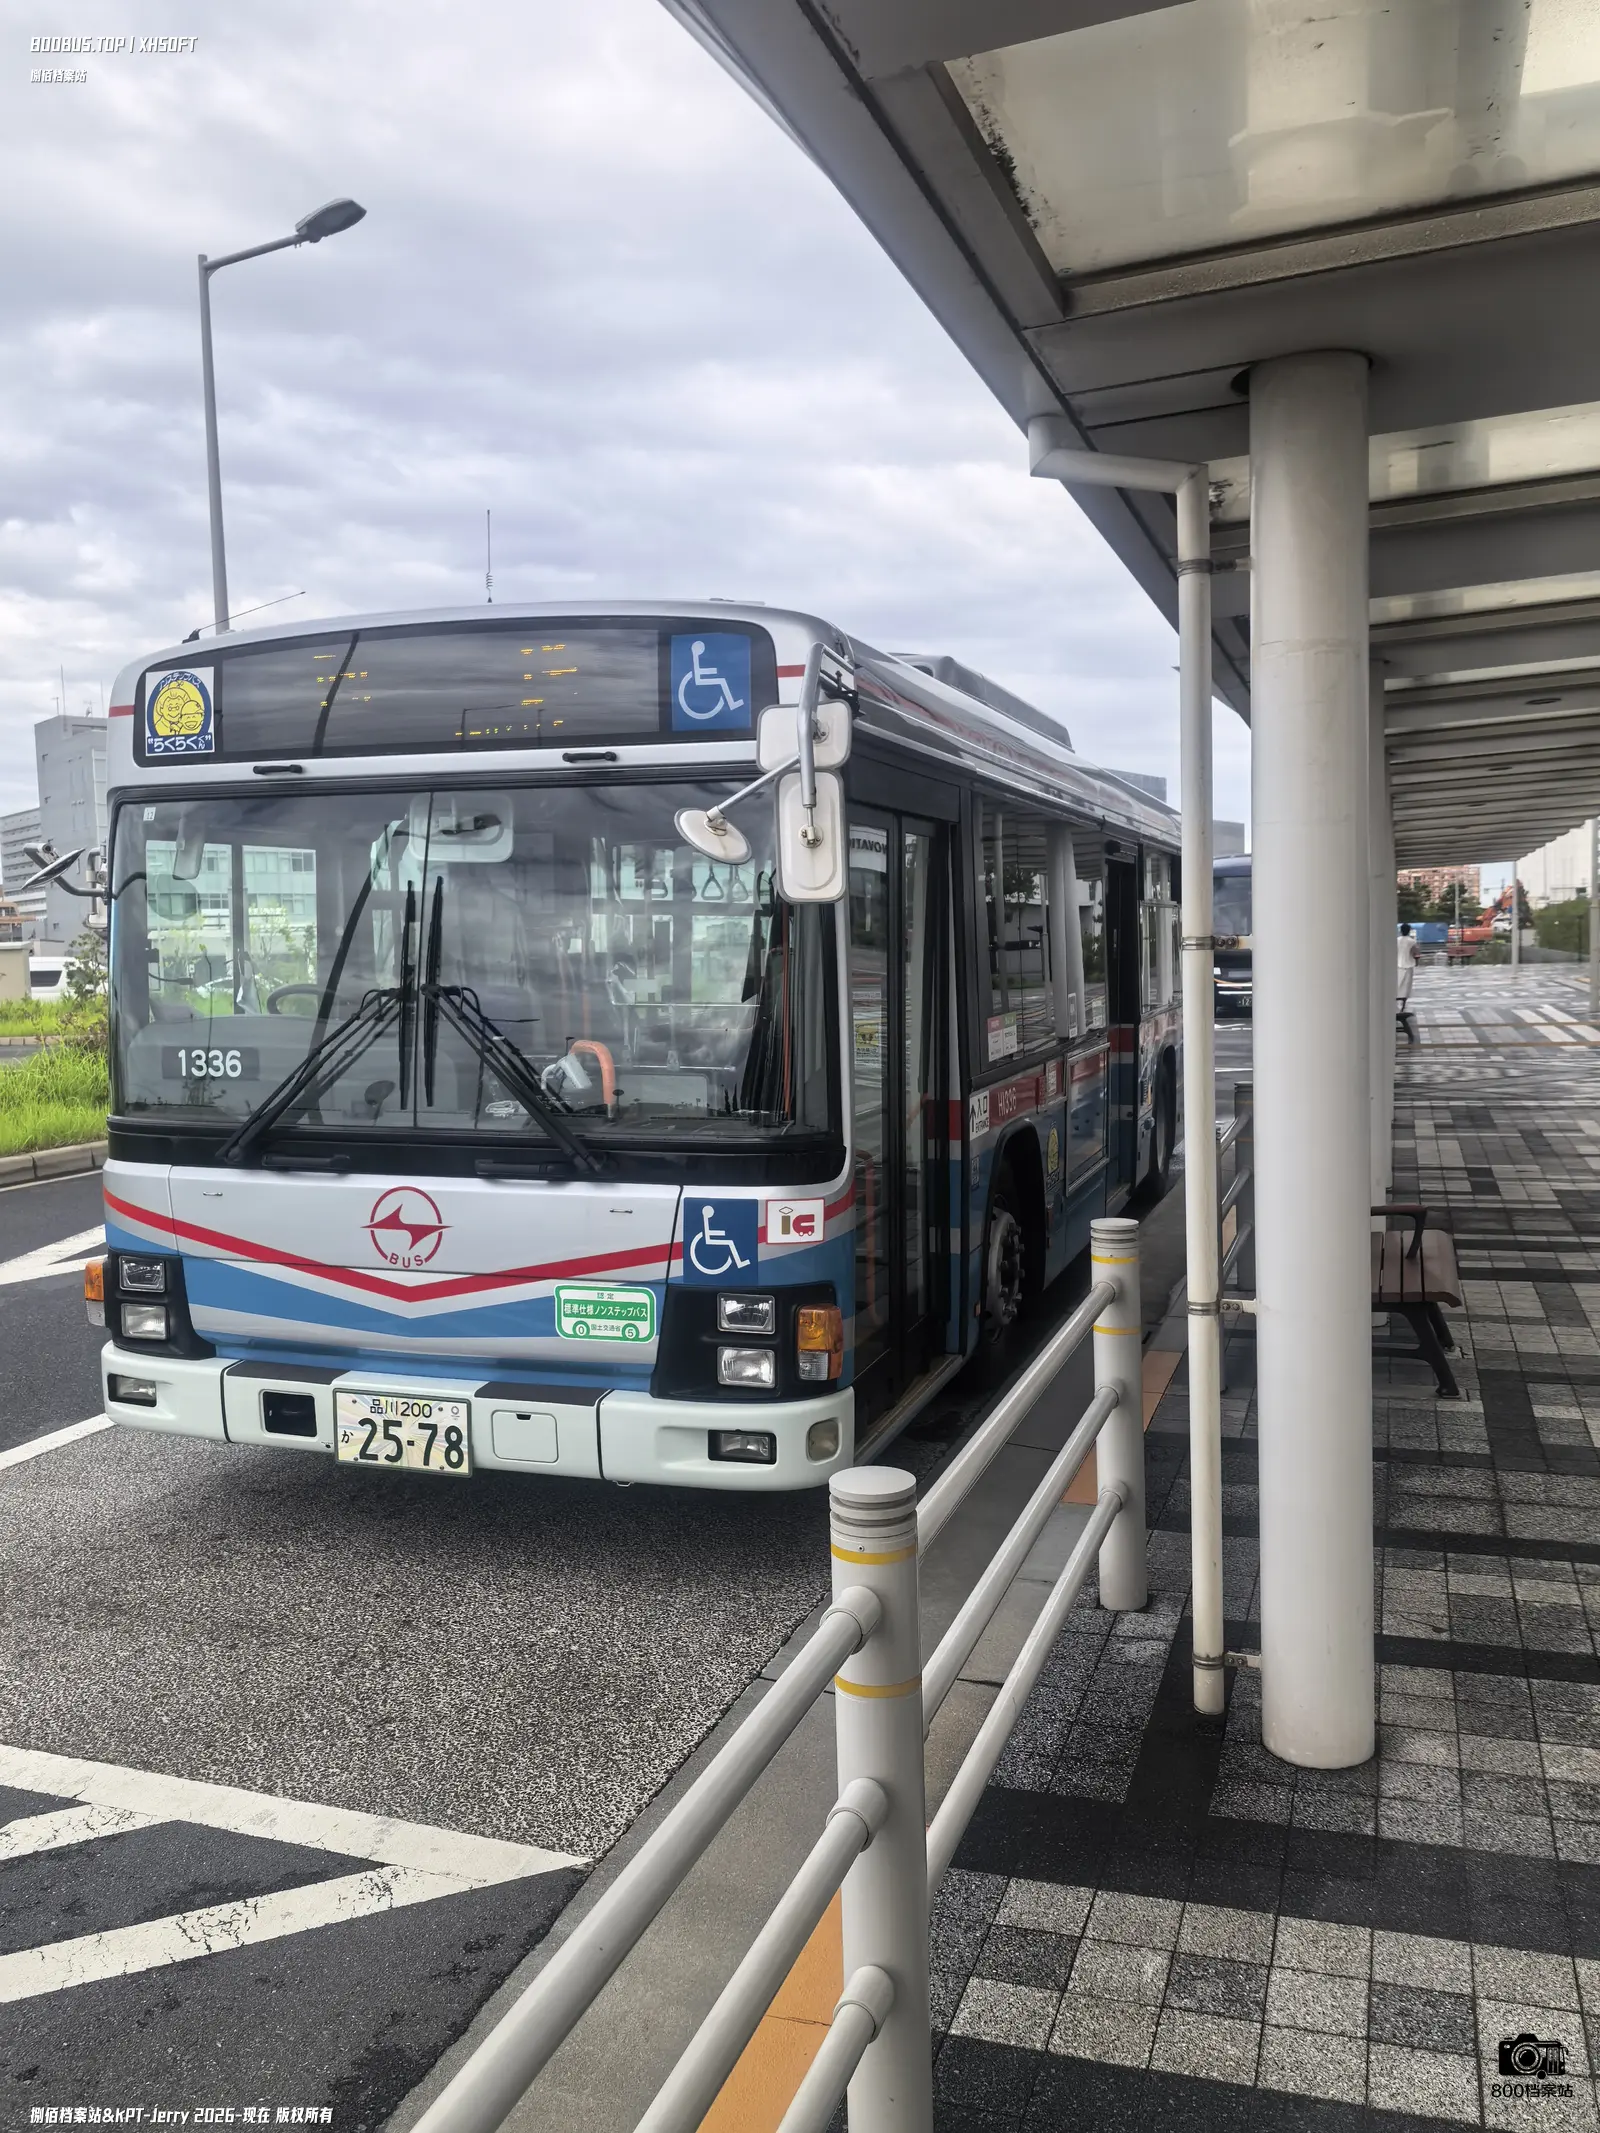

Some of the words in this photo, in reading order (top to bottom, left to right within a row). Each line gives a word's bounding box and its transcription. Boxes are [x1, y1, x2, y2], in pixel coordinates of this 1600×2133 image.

[178, 1049, 242, 1077] 1336
[977, 1095, 988, 1118] 入口
[388, 1252, 424, 1269] BUS
[564, 1303, 648, 1318] 標準仕様ノンステップバス
[578, 1326, 585, 1335] 0
[627, 1328, 634, 1338] 5
[341, 1430, 354, 1444] か
[358, 1417, 464, 1469] 25-78
